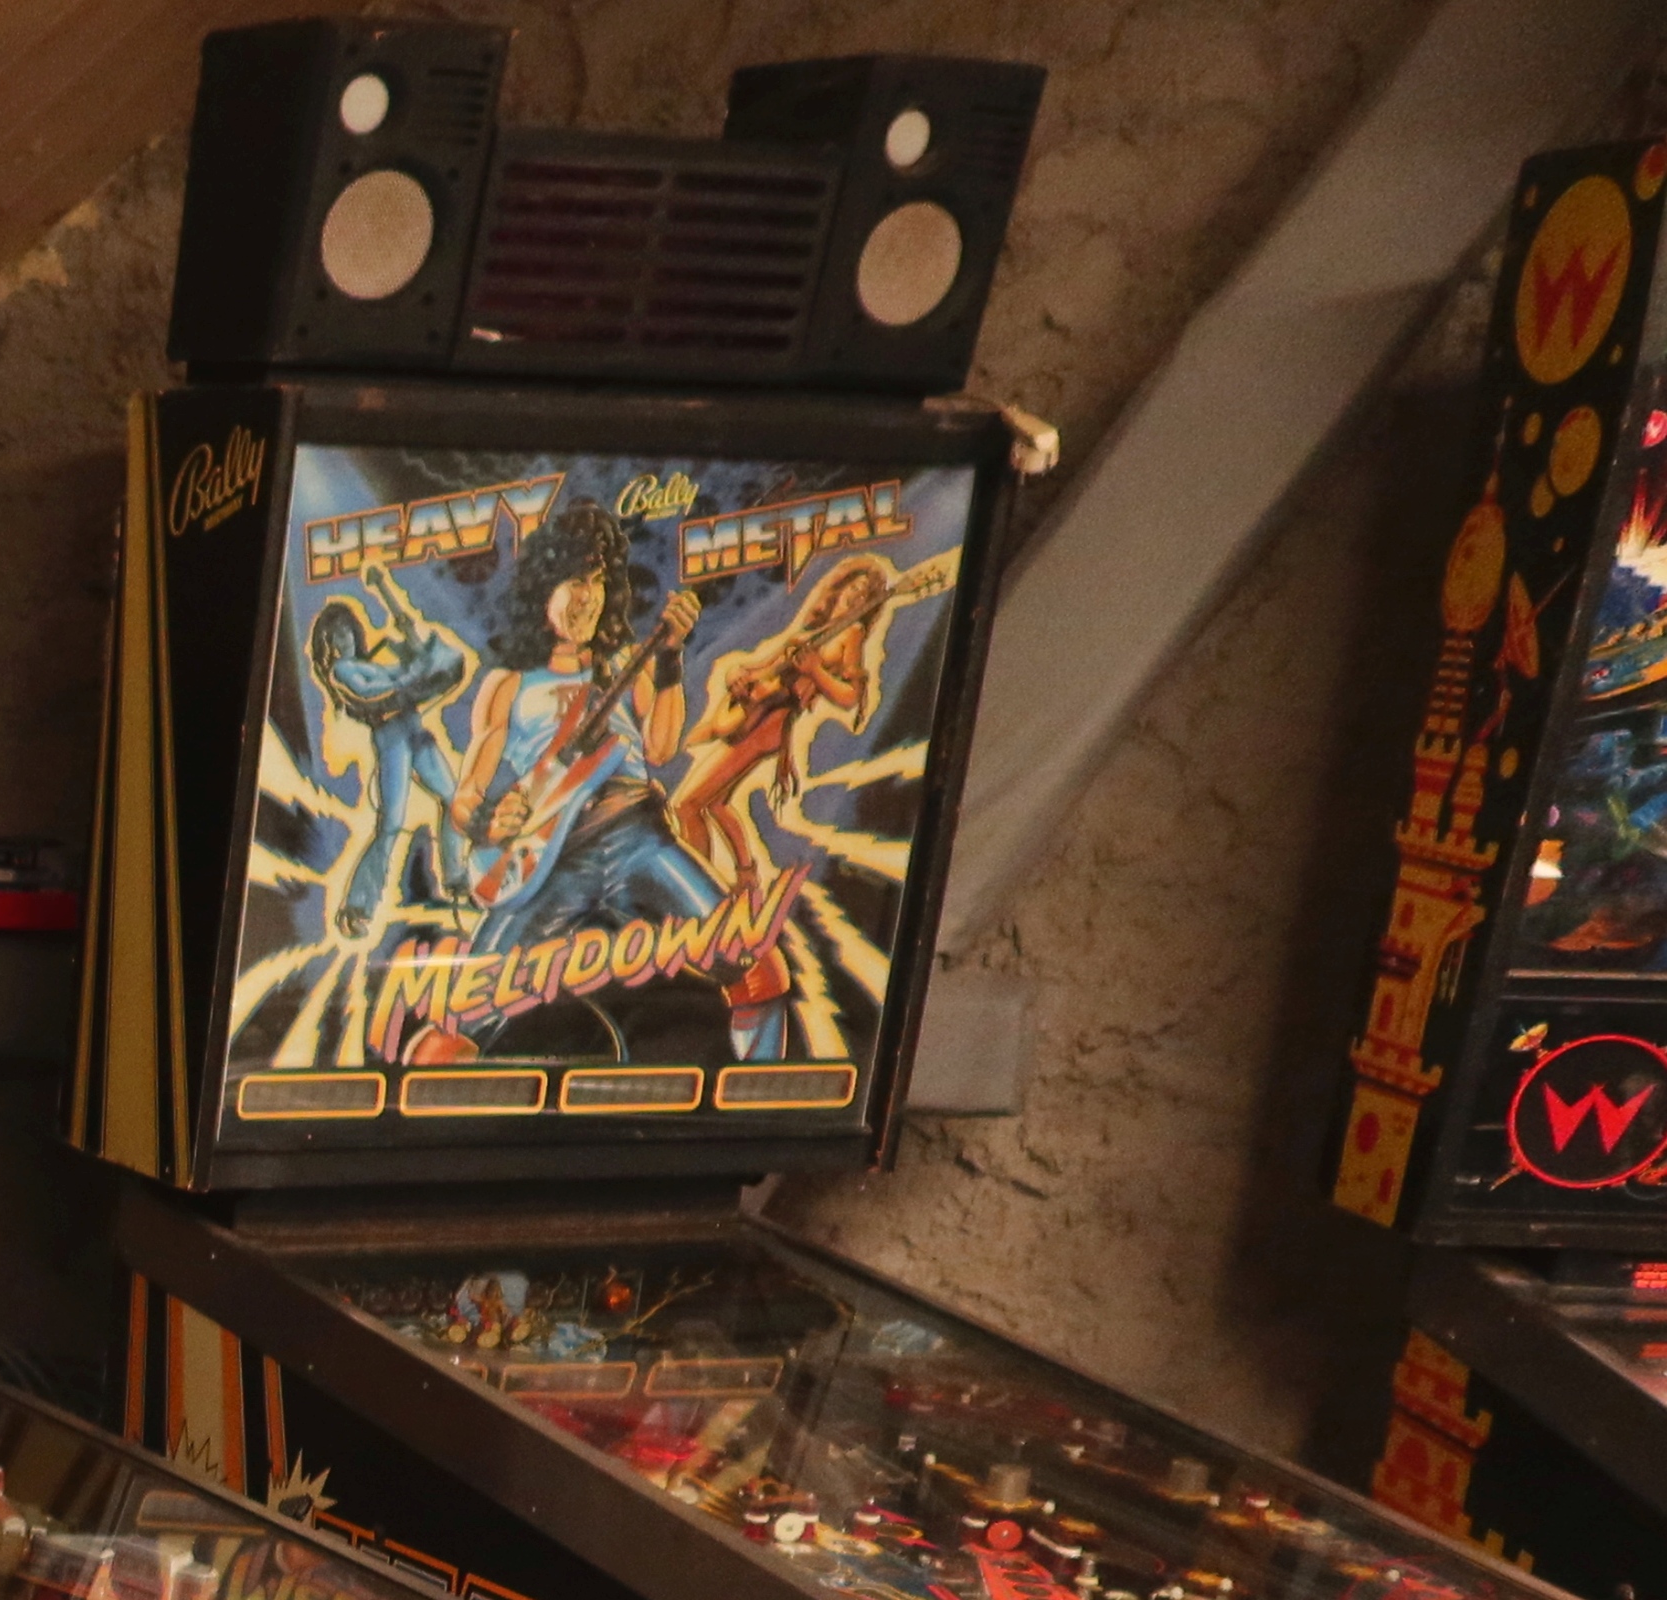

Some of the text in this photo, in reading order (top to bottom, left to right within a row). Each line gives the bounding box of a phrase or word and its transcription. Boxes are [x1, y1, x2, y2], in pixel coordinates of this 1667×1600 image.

[170, 425, 266, 536] Bally
[307, 473, 565, 584] HEAVY
[616, 471, 701, 518] Bally
[680, 480, 913, 588] METAL
[367, 863, 813, 1060] MELTDOWN
